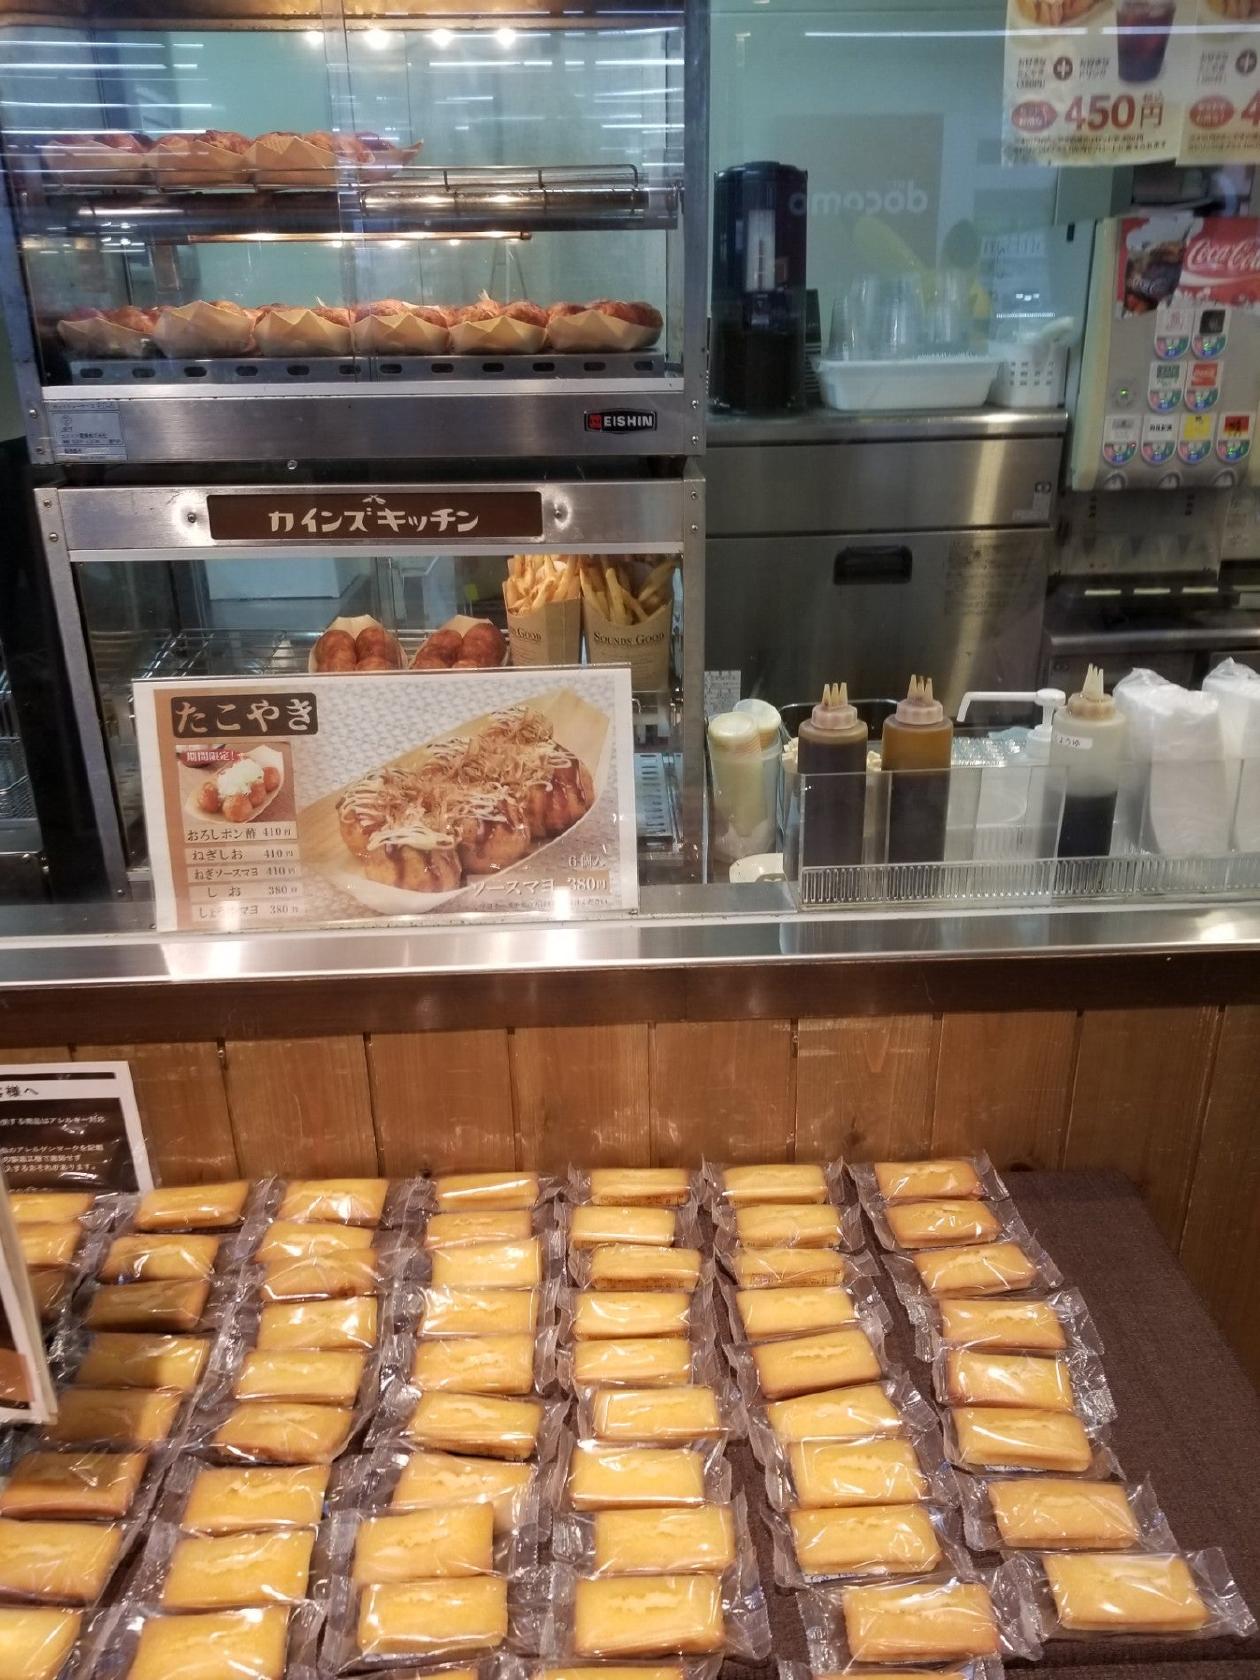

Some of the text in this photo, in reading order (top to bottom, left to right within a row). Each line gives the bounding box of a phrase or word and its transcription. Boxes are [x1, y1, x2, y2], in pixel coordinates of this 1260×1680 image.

[268, 507, 479, 533] カインズキッチン
[175, 699, 313, 733] たこやき
[192, 848, 243, 861] ねぎしお
[194, 867, 259, 880] ねぎソースマヨ
